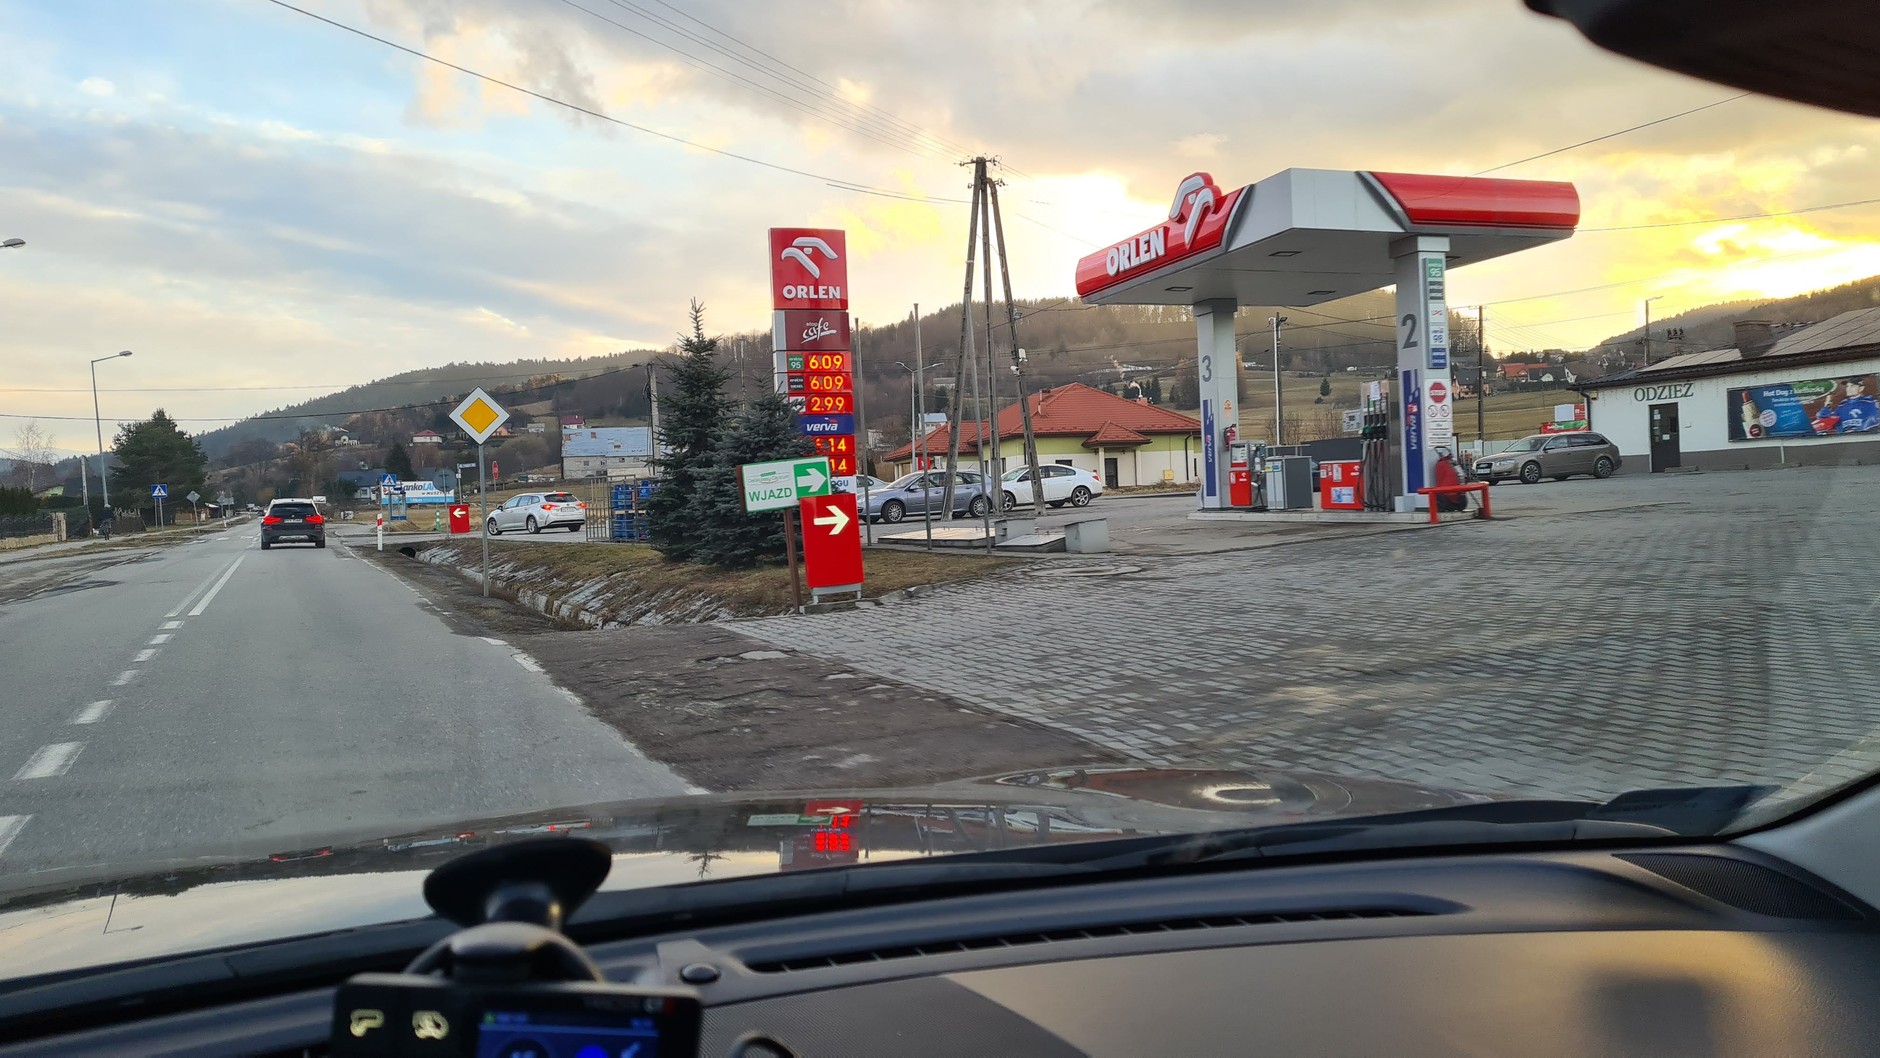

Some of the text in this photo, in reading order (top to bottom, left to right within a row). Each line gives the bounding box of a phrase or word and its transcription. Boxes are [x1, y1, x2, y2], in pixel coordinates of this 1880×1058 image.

[1106, 226, 1165, 277] ORLEN
[782, 284, 841, 299] ORLEN
[802, 317, 832, 341] cafe
[1401, 313, 1418, 350] 2
[790, 361, 802, 369] 95
[809, 355, 843, 370] 6.09
[1201, 354, 1212, 383] 3
[810, 375, 844, 390] 6.09
[811, 396, 845, 411] 2.99
[806, 423, 839, 432] verva
[748, 487, 793, 502] WJAZD
